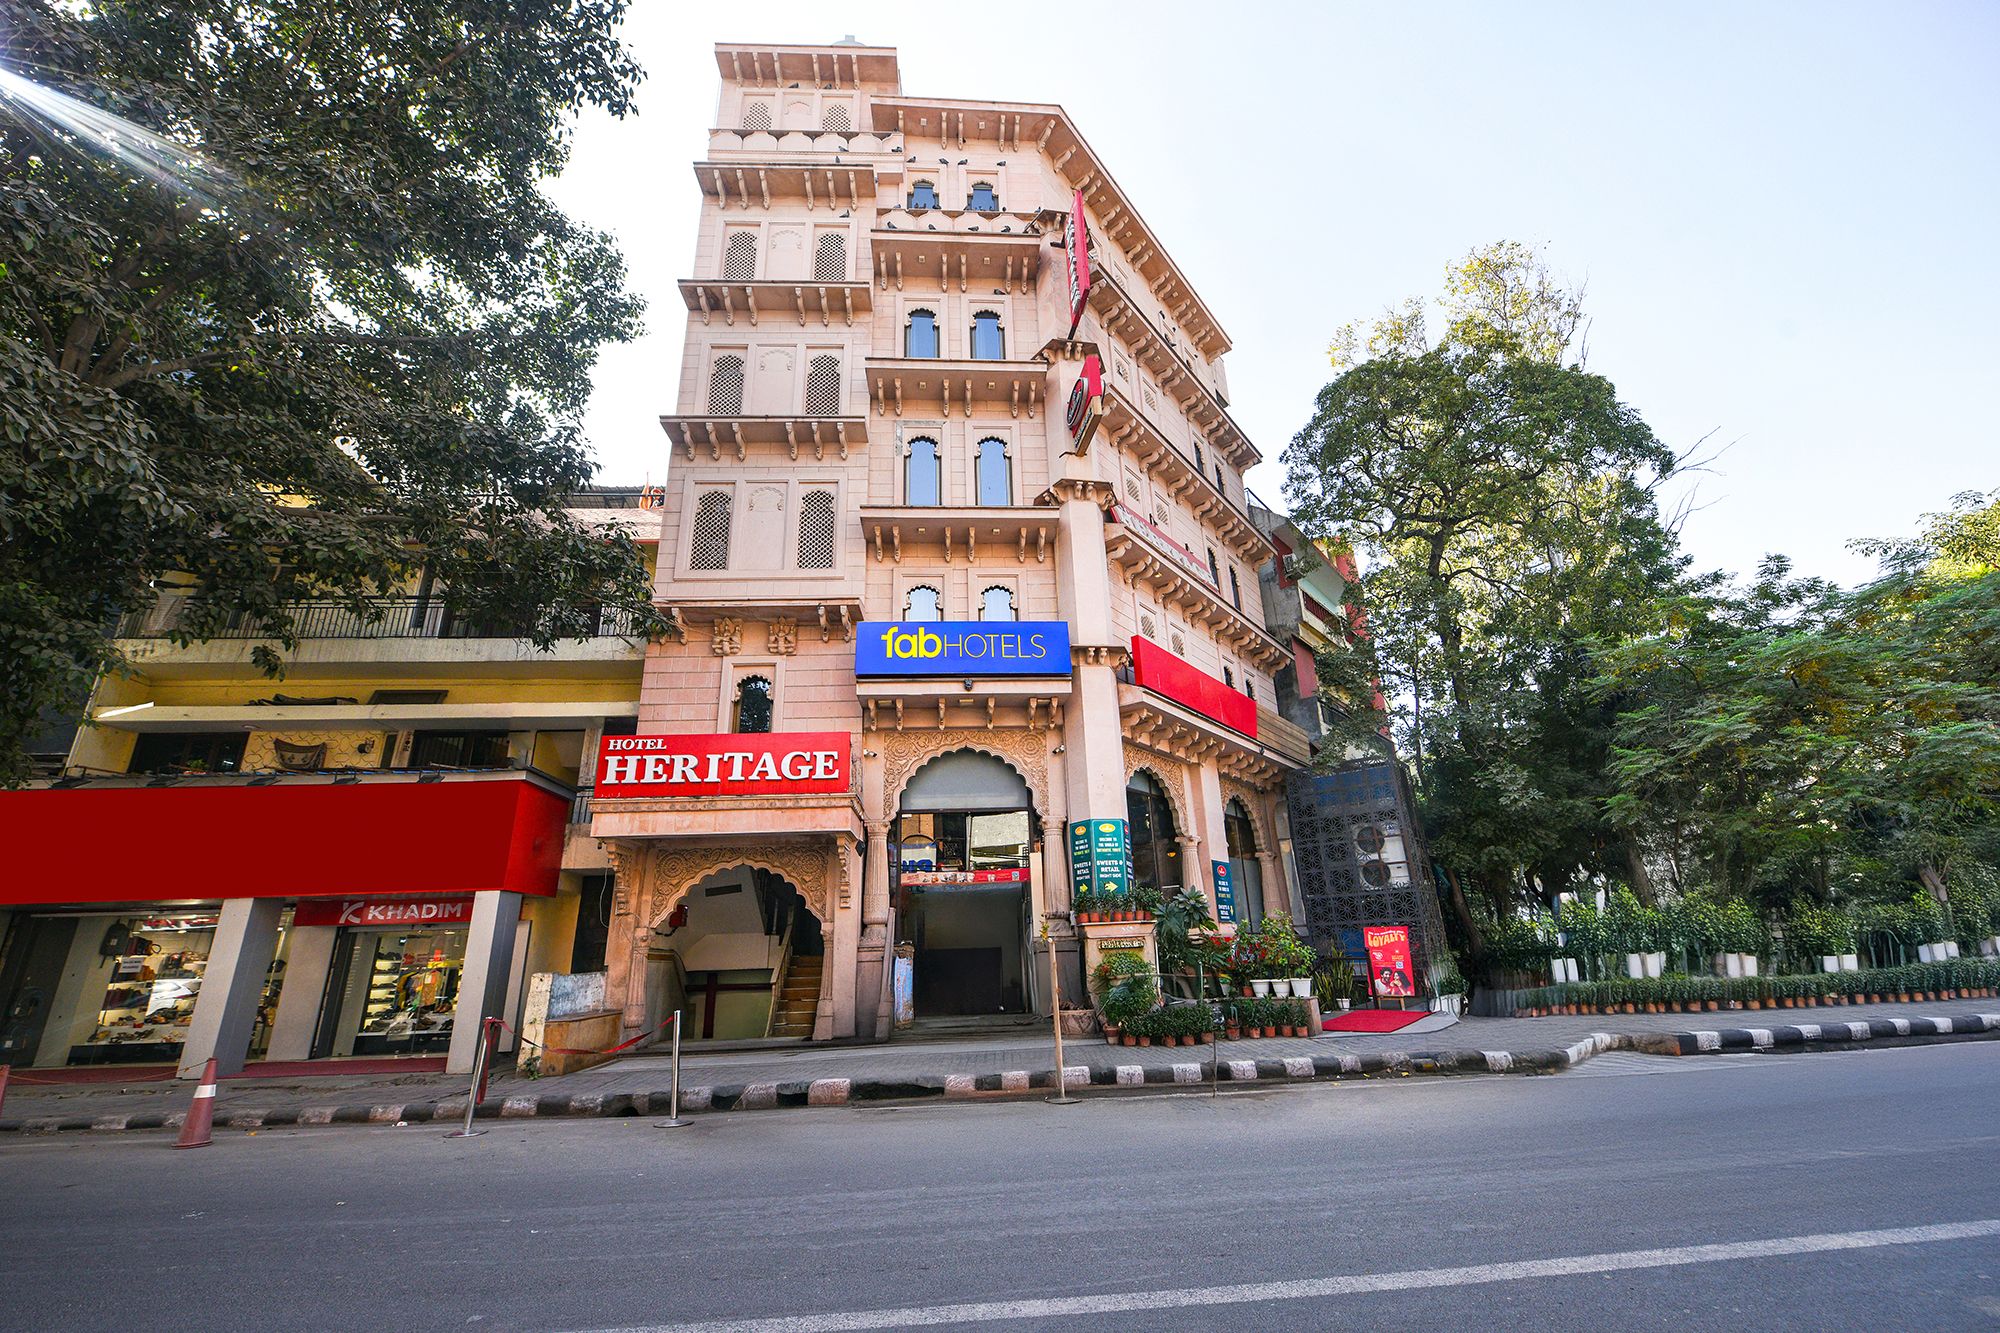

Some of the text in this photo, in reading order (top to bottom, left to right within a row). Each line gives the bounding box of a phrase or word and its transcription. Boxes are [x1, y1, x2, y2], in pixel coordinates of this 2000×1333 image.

[608, 738, 667, 751] HOTEL
[601, 751, 840, 785] HERITAGE
[367, 903, 463, 920] KHADIM
[1368, 931, 1405, 947] LOYALTY
